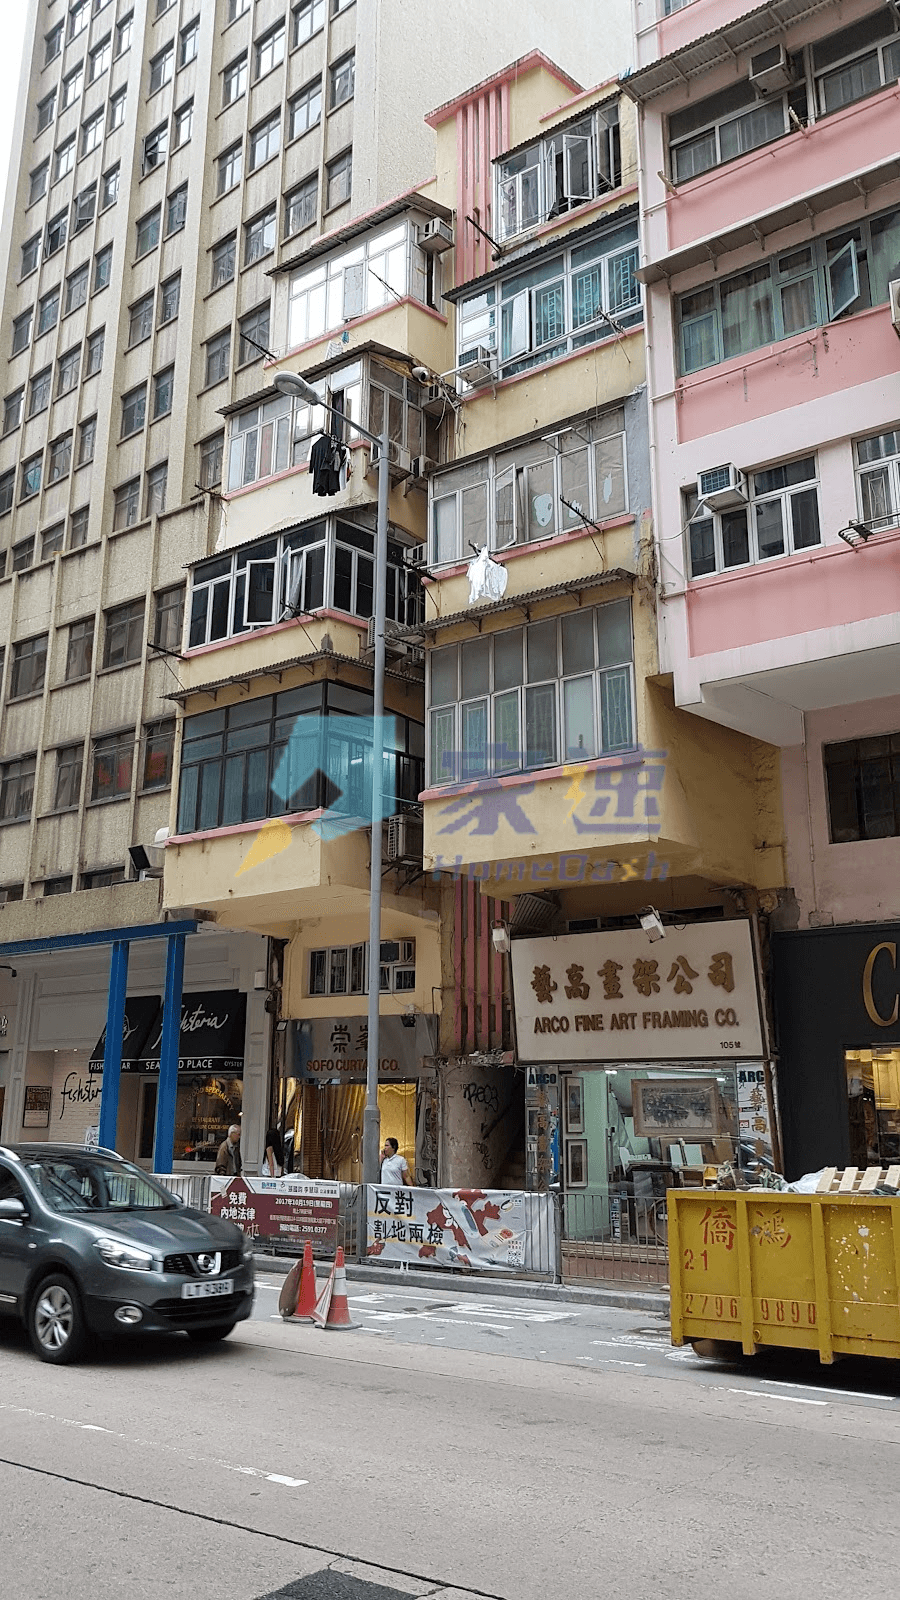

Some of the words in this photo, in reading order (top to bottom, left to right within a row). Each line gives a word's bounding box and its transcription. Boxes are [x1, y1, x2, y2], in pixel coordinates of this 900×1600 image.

[530, 951, 736, 1004] 藝高畫架公司
[534, 1015, 570, 1034] ARCO
[574, 1013, 604, 1032] FINE
[610, 1012, 638, 1031] ART
[642, 1009, 709, 1030] FRAMING
[714, 1008, 740, 1028] CO.
[186, 1059, 213, 1069] PLACE
[224, 1060, 243, 1068] OYSTER
[306, 1059, 335, 1072] SOFO
[381, 1058, 400, 1071] CO.
[528, 1073, 557, 1085] ARCO
[738, 1070, 765, 1083] ARC
[229, 1191, 248, 1206] 免費
[374, 1190, 414, 1217] 反對
[220, 1206, 256, 1221] 內地法律
[373, 1219, 444, 1246] 割地兩檢
[683, 1248, 709, 1272] 21
[685, 1294, 738, 1319] 2796
[760, 1298, 816, 1325] 9890
